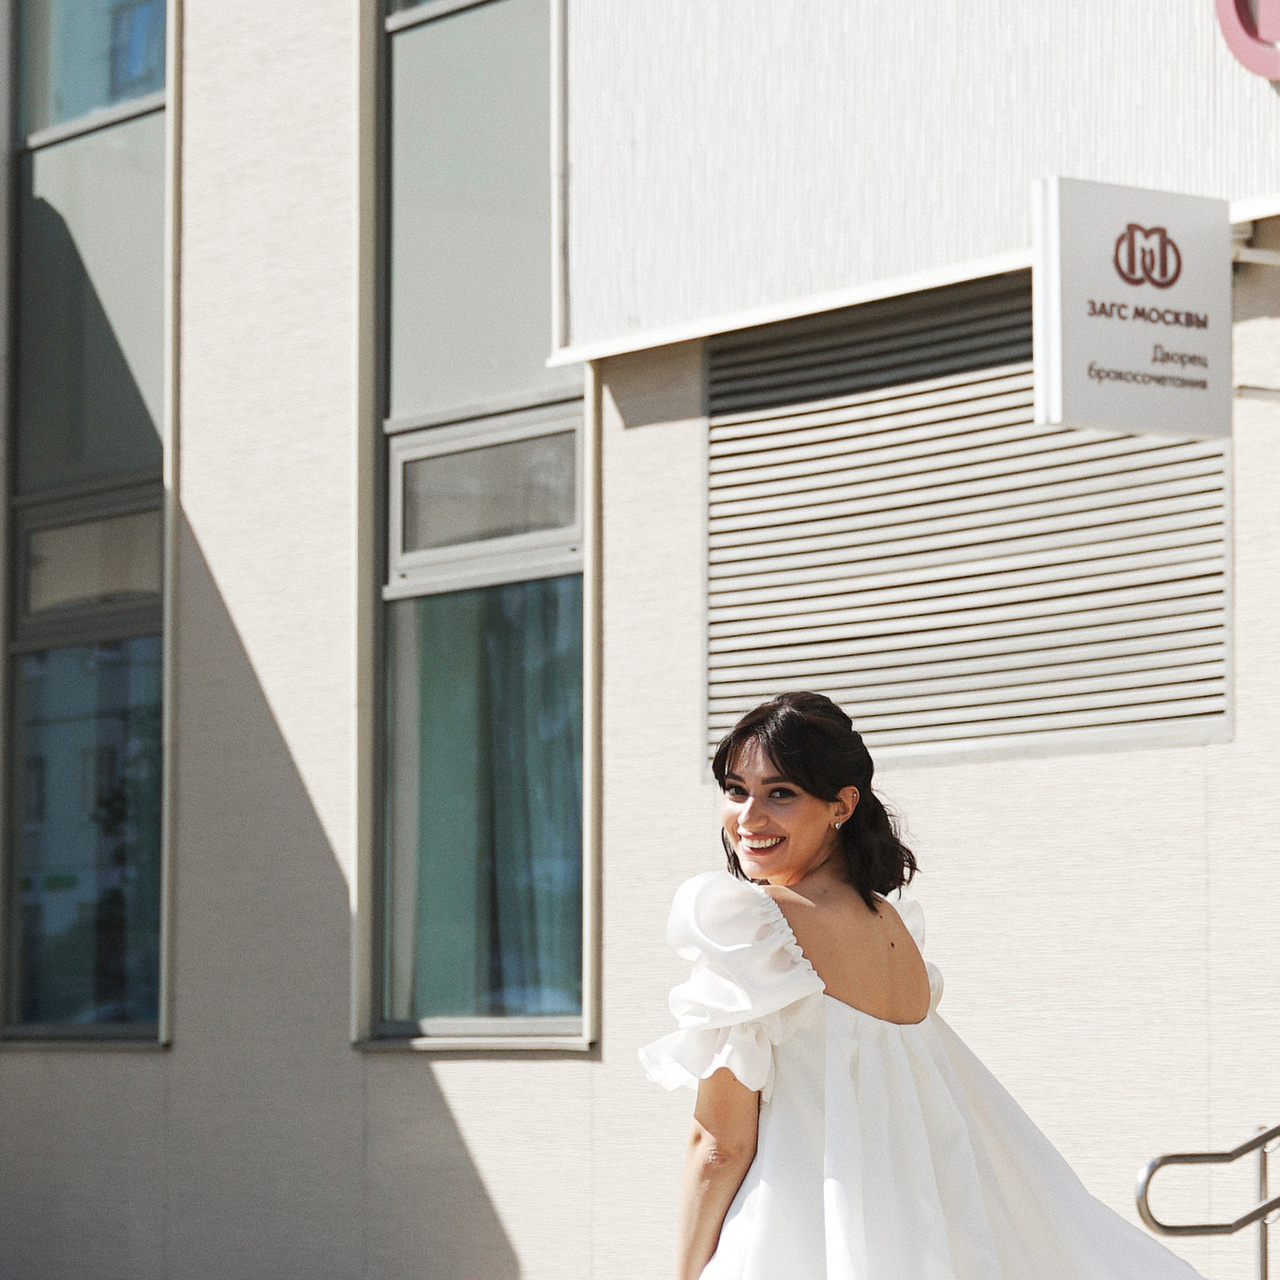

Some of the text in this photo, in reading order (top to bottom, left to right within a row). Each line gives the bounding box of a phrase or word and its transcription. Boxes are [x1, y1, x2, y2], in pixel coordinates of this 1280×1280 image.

[1087, 299, 1208, 329] ЗАГС МОСКВЫ
[1152, 344, 1208, 368] Дворец
